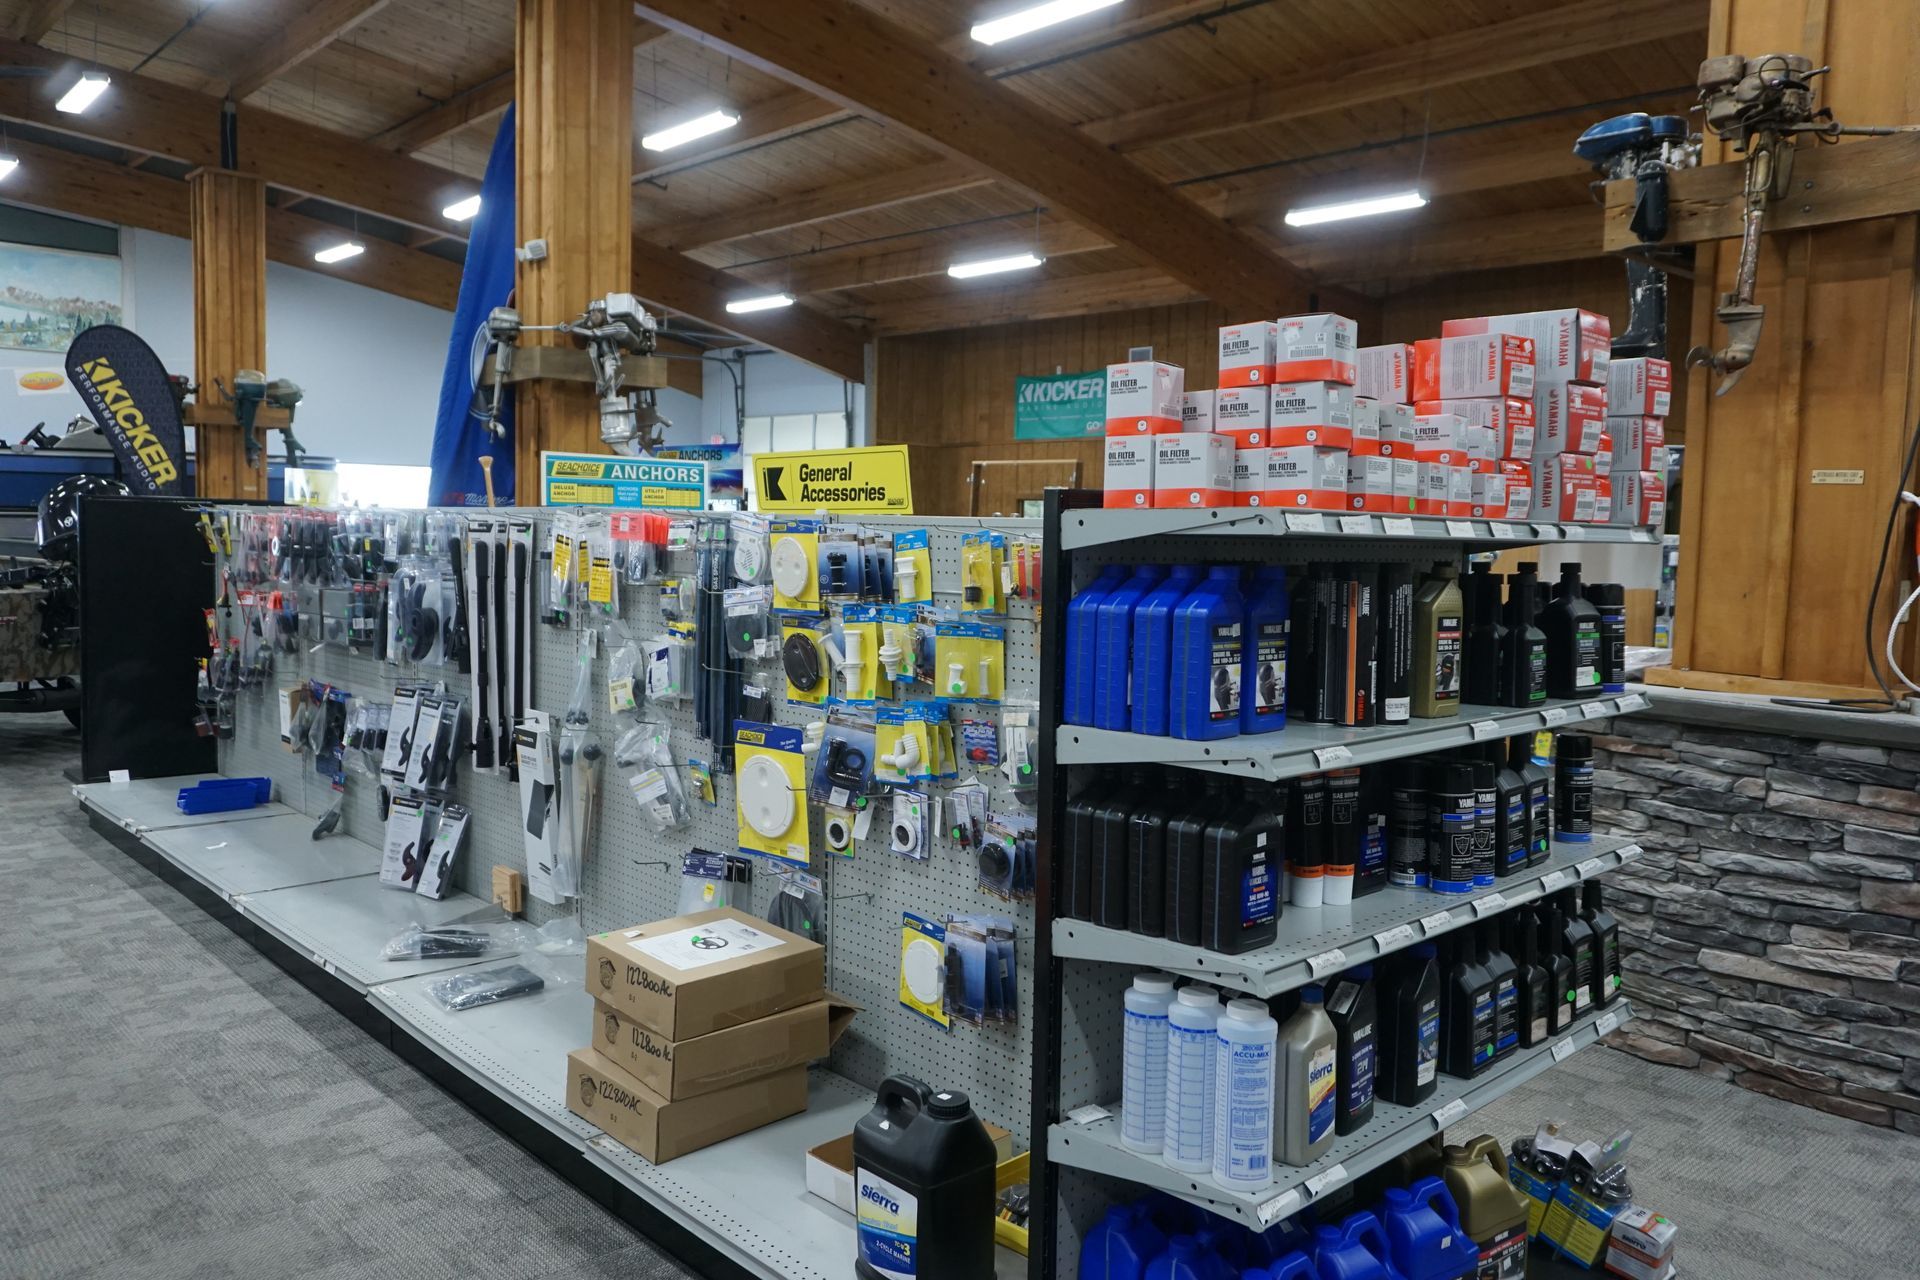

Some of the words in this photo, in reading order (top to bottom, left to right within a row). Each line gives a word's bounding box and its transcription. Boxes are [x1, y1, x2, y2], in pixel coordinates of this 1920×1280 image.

[1223, 341, 1231, 350] OIL
[1232, 339, 1249, 349] FILTER
[1559, 327, 1569, 367] YAMAHA
[1393, 359, 1401, 390] YAMAHA
[1488, 349, 1496, 381] YAMAHA
[1034, 378, 1104, 402] KICKER
[1111, 380, 1119, 388] OIL
[1120, 379, 1138, 387] FILTER
[74, 366, 131, 449] PERFORMANCE
[1183, 407, 1197, 415] ILTER
[1220, 403, 1228, 411] OIL
[1229, 402, 1248, 411] FILTER
[1286, 398, 1305, 407] FILTER
[92, 370, 177, 487] KICKER
[1548, 400, 1559, 438] YAMAHA
[1419, 427, 1439, 435] FILTER
[678, 450, 723, 461] ANCHORS
[1117, 451, 1135, 459] FILTER
[1160, 450, 1168, 458] OIL
[1169, 449, 1189, 457] FILTER
[131, 455, 156, 490] AUDIO
[556, 461, 600, 472] SEACHOICE
[611, 465, 700, 482] ANCHORS
[799, 461, 852, 482] General
[1268, 463, 1277, 471] OIL
[1278, 462, 1296, 470] FILTER
[801, 482, 886, 502] Accessories
[1542, 470, 1553, 508] YAMAHA
[1362, 586, 1370, 617] YAMALUBE
[626, 965, 673, 997] 122800AC
[1310, 1063, 1333, 1083] sierra
[599, 1080, 643, 1116] 122800AC
[861, 1184, 900, 1214] sierra
[876, 1240, 893, 1255] 2-CYCLE
